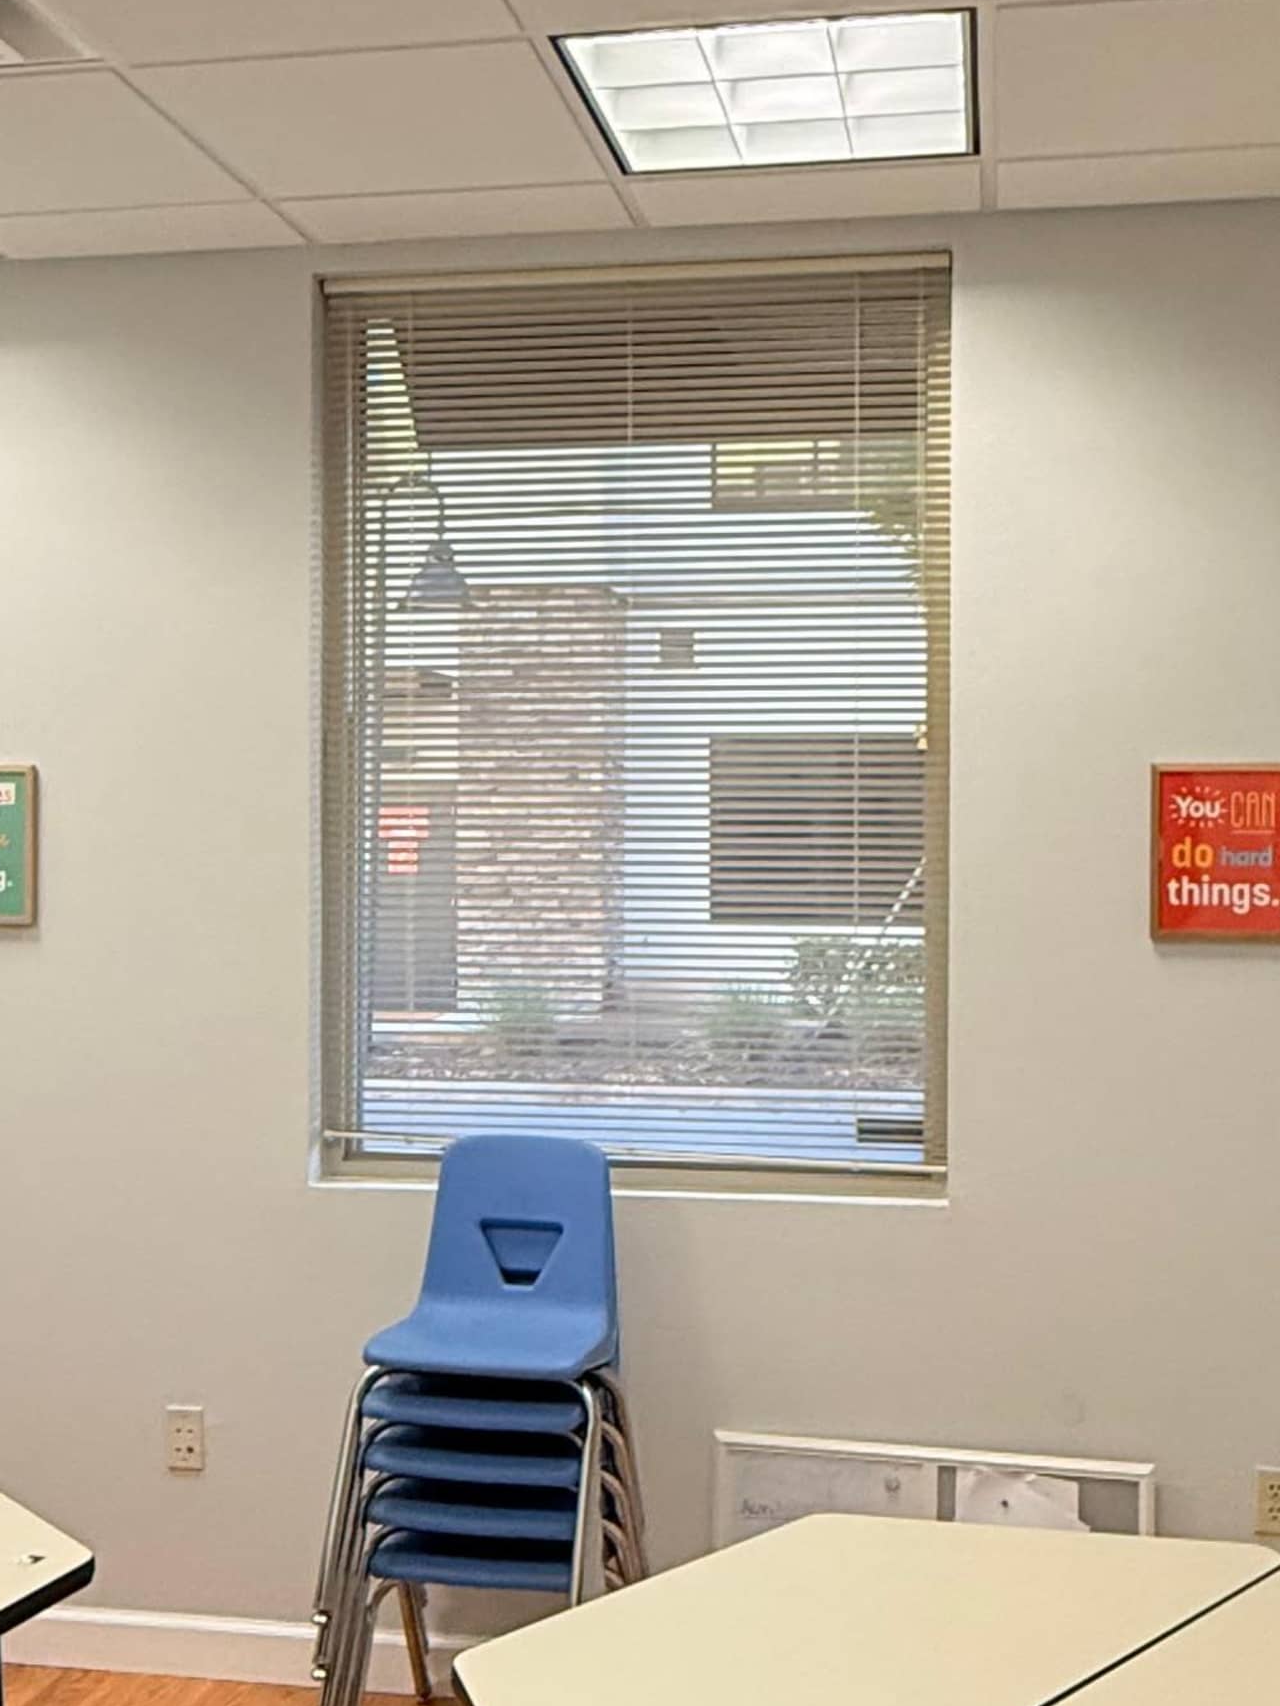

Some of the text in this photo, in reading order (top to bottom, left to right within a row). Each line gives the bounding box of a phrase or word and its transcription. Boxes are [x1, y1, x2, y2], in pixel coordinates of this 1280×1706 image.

[1175, 791, 1276, 828] You CAN
[1172, 836, 1273, 869] do hard
[1167, 875, 1280, 914] things.
